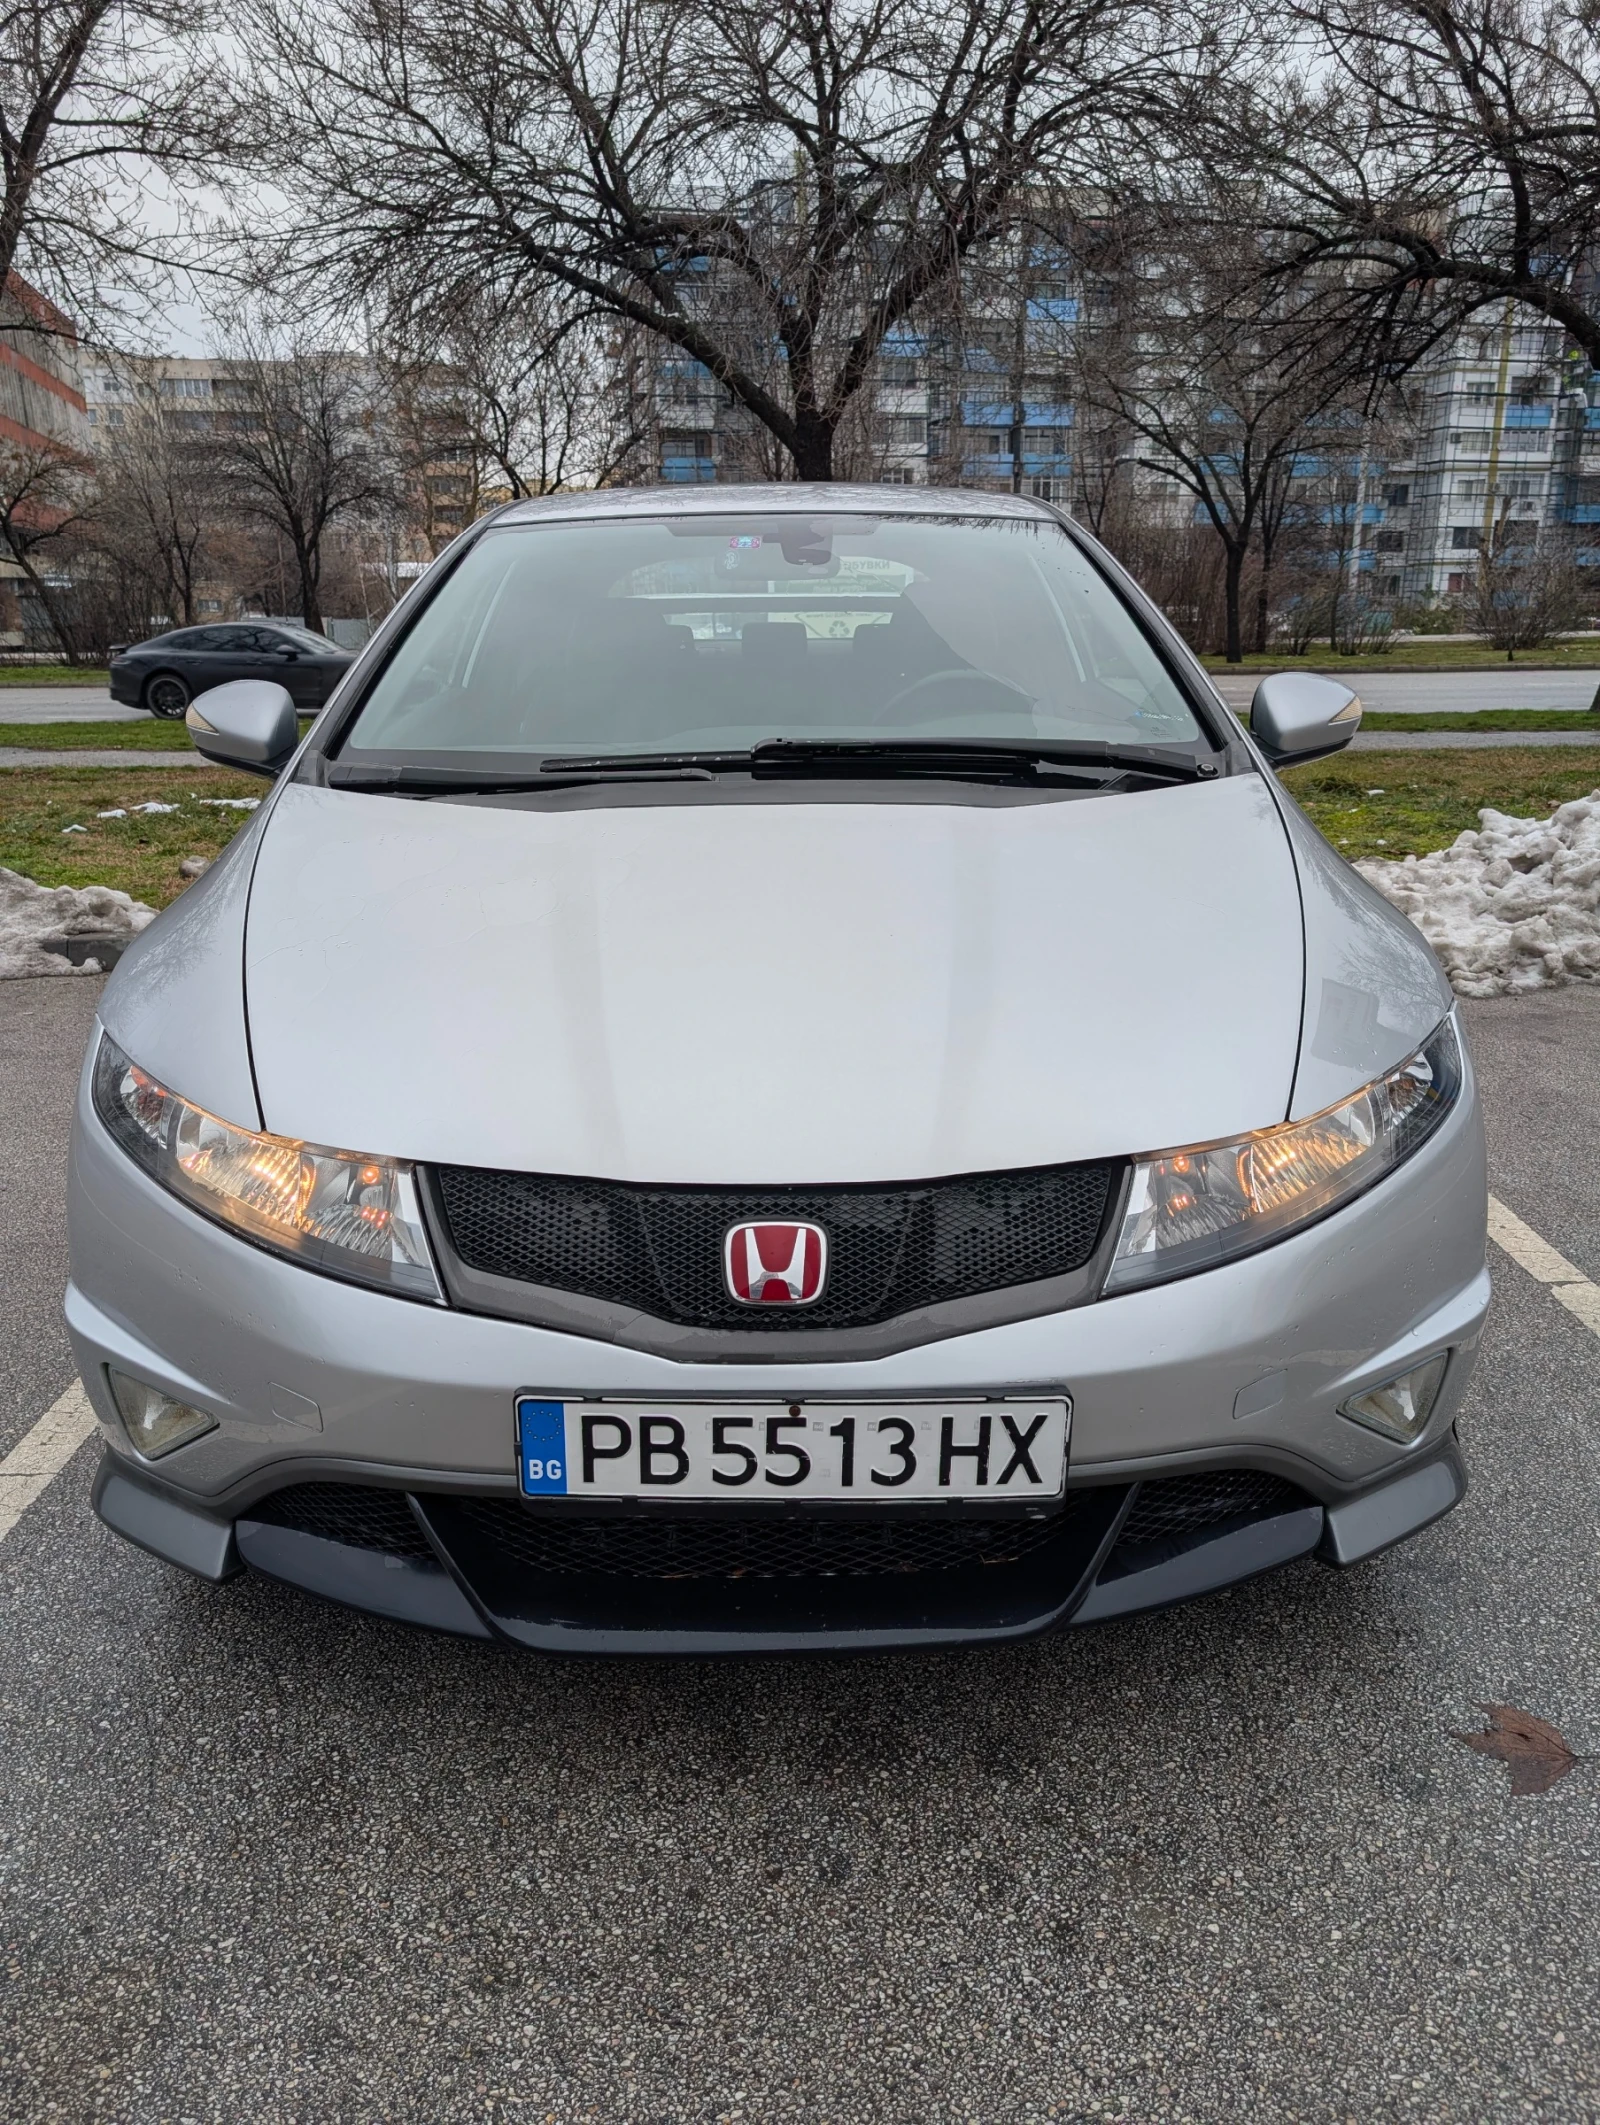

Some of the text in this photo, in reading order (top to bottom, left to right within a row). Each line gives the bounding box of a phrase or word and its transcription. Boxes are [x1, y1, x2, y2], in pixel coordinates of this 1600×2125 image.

[529, 1459, 562, 1480] BG
[581, 1415, 1048, 1487] PB 5513 HX
